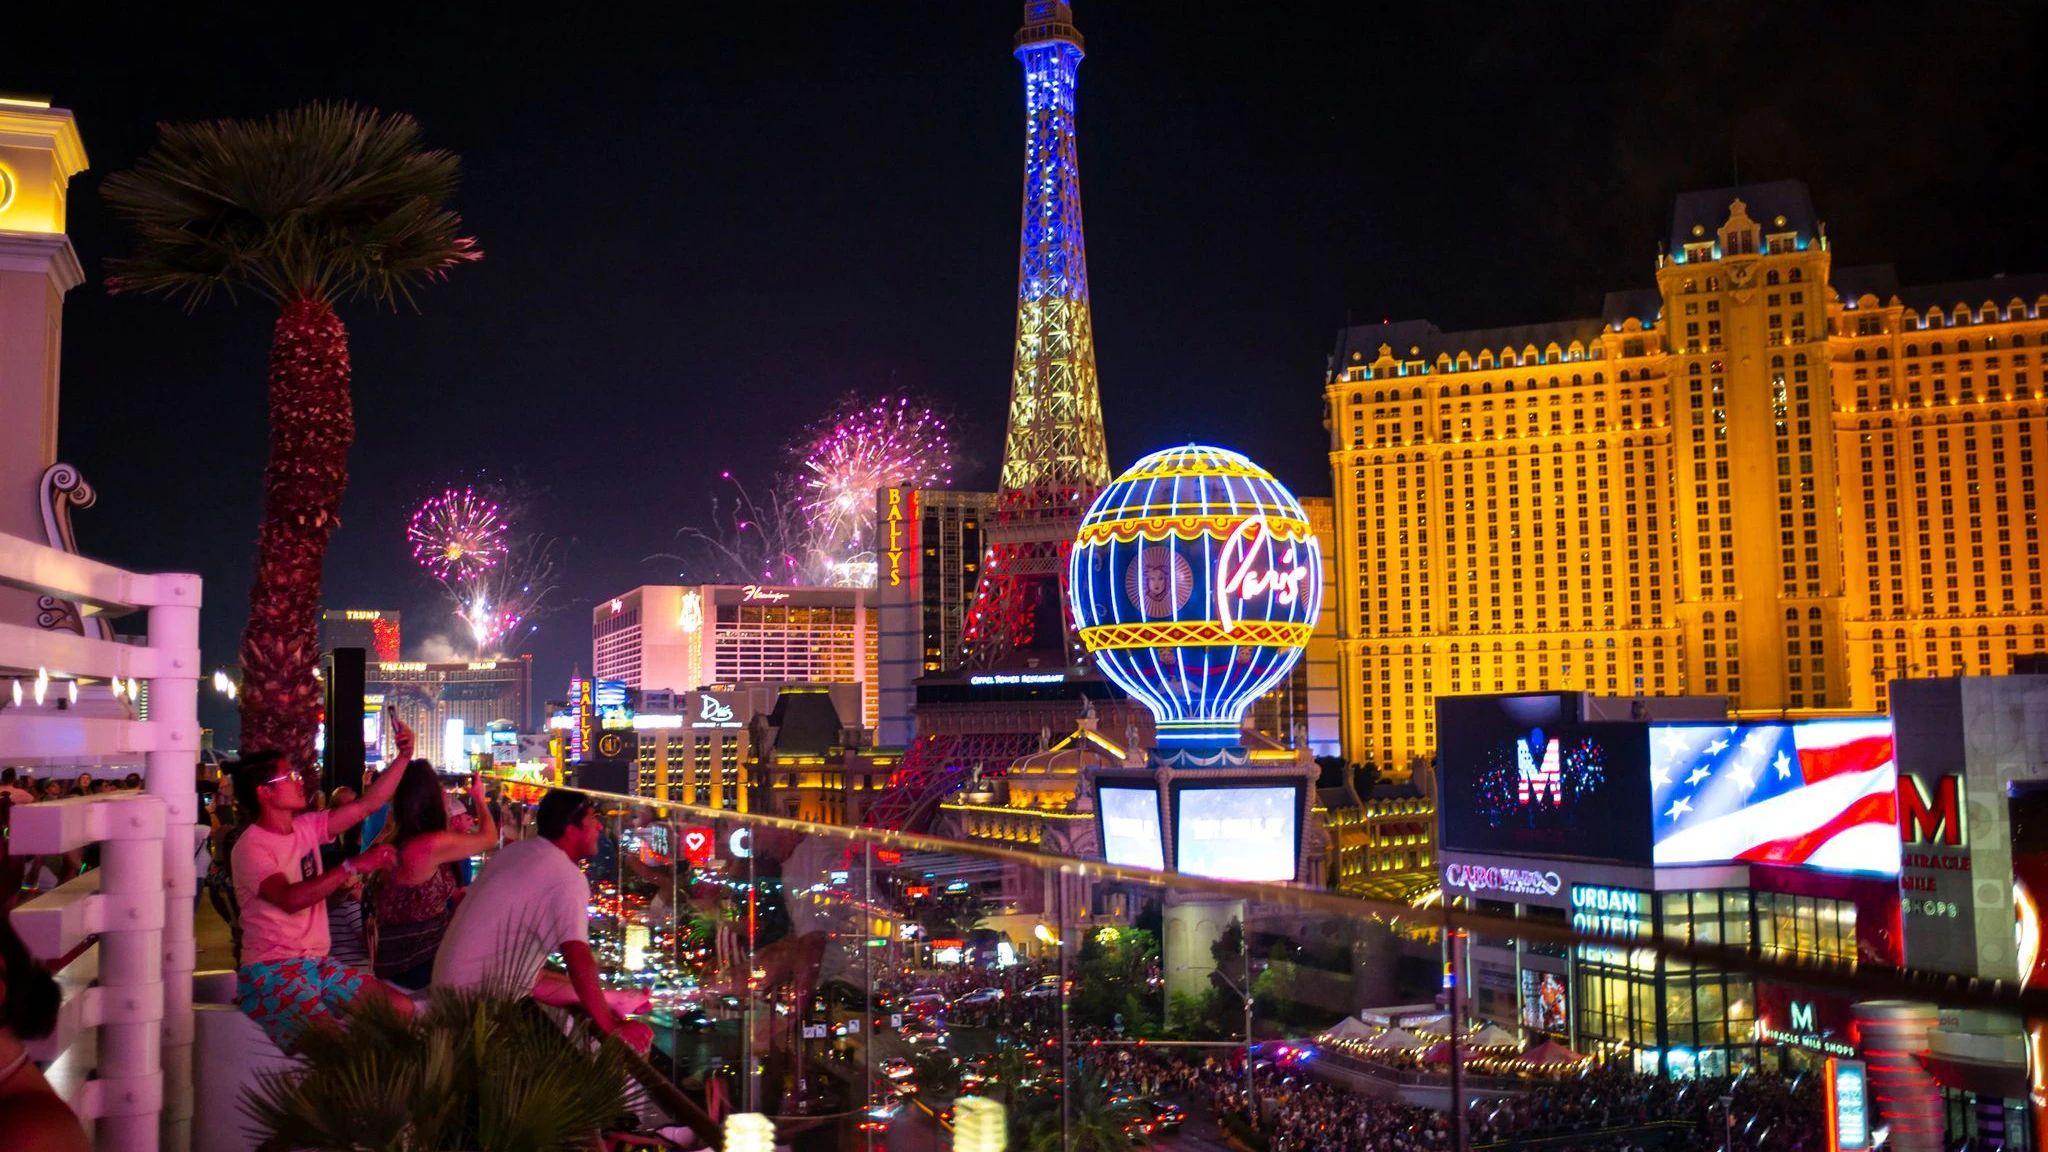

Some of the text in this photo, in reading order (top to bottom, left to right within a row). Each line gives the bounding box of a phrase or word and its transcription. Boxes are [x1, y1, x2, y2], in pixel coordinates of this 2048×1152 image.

[1217, 514, 1307, 633] Paris
[742, 585, 790, 603] Flamingo
[346, 611, 381, 620] TRUMP
[1898, 774, 1966, 846] M
[1902, 853, 1970, 872] MIRACLE
[1902, 876, 1937, 893] MILE
[1572, 886, 1638, 914] URBAN
[1902, 898, 1959, 918] SHOPS
[1791, 1001, 1814, 1032] M
[1765, 1029, 1855, 1058] MIRACLE MILE SHOPS
